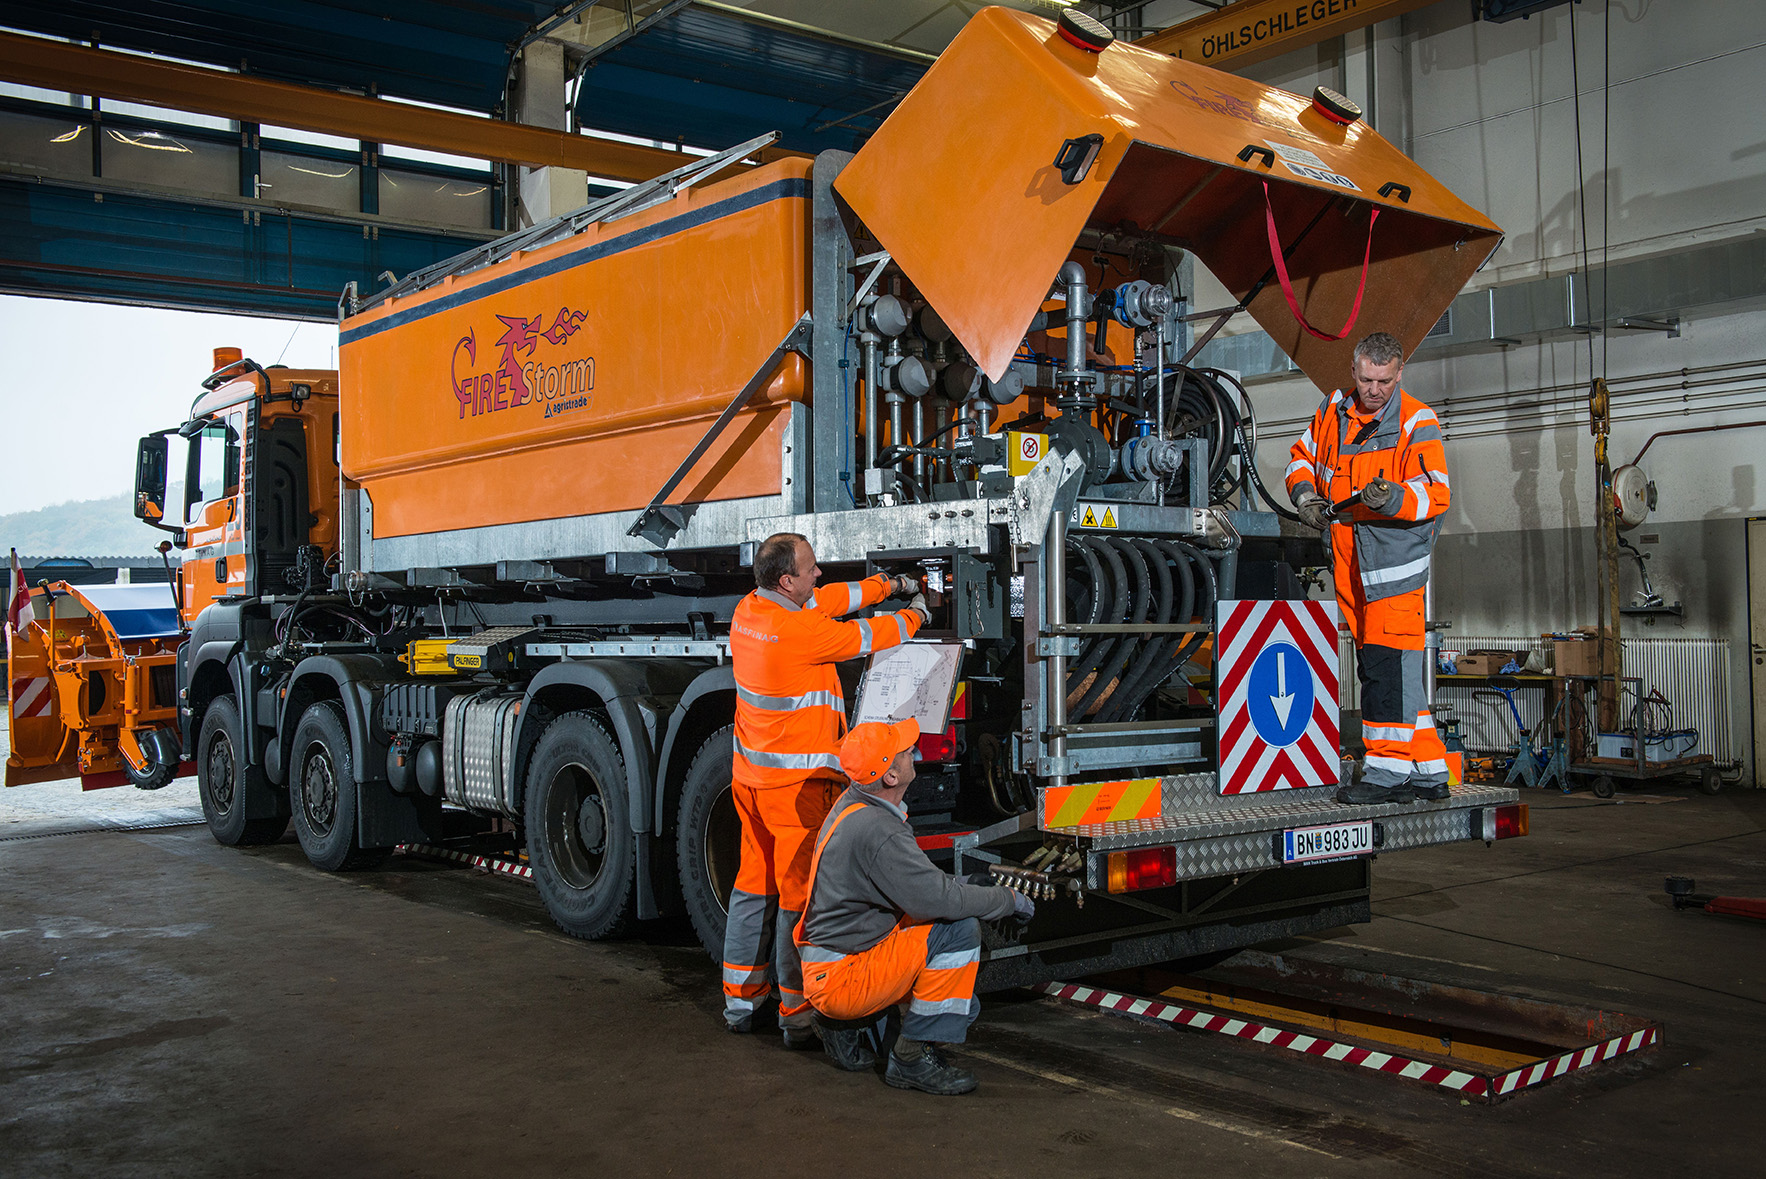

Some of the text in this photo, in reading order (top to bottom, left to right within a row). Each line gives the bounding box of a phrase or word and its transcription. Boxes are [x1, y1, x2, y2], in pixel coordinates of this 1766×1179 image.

[520, 356, 596, 405] Storm
[553, 396, 588, 414] agristrade
[737, 625, 779, 643] ASFINAG
[1297, 827, 1368, 855] BN 983 JU
